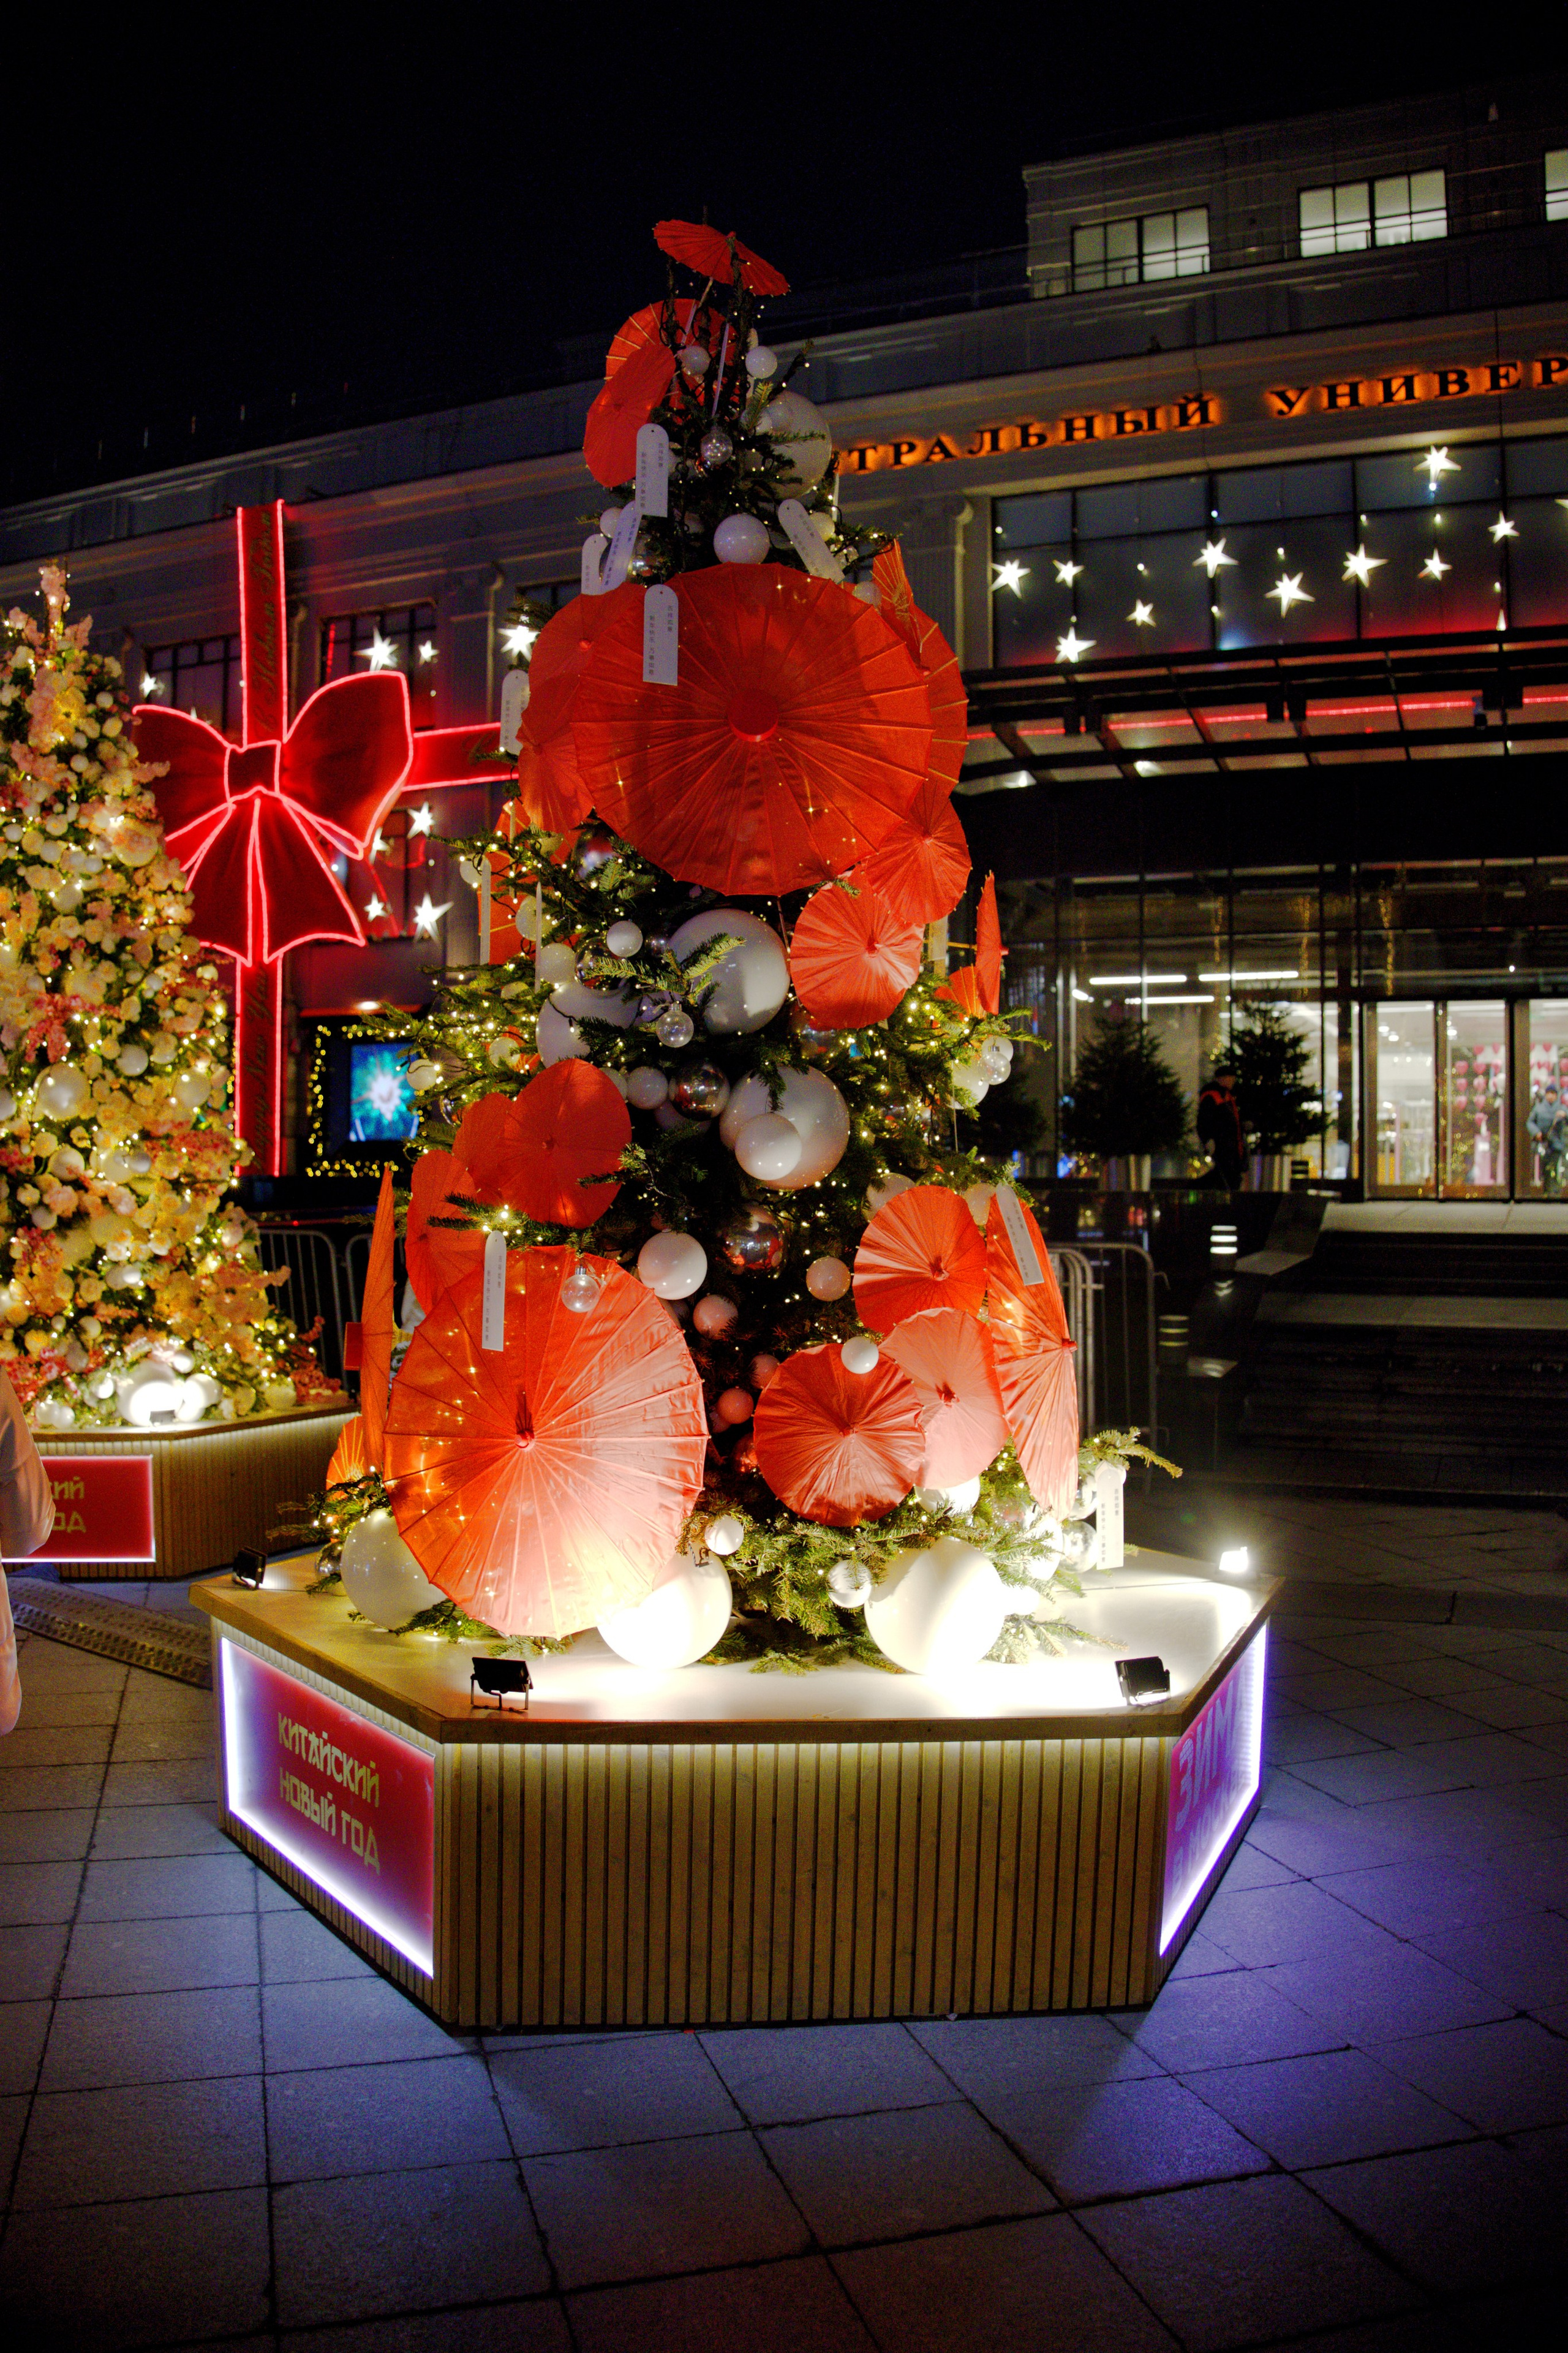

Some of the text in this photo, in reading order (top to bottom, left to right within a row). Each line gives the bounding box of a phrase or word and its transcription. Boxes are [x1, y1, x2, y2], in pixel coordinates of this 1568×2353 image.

[848, 357, 1568, 470] ТРАЛЬНЫЙ УНИВЕР
[278, 1712, 380, 1808] КИТАЙСКИЙ
[279, 1766, 381, 1876] НОВЫЙ ГОД
